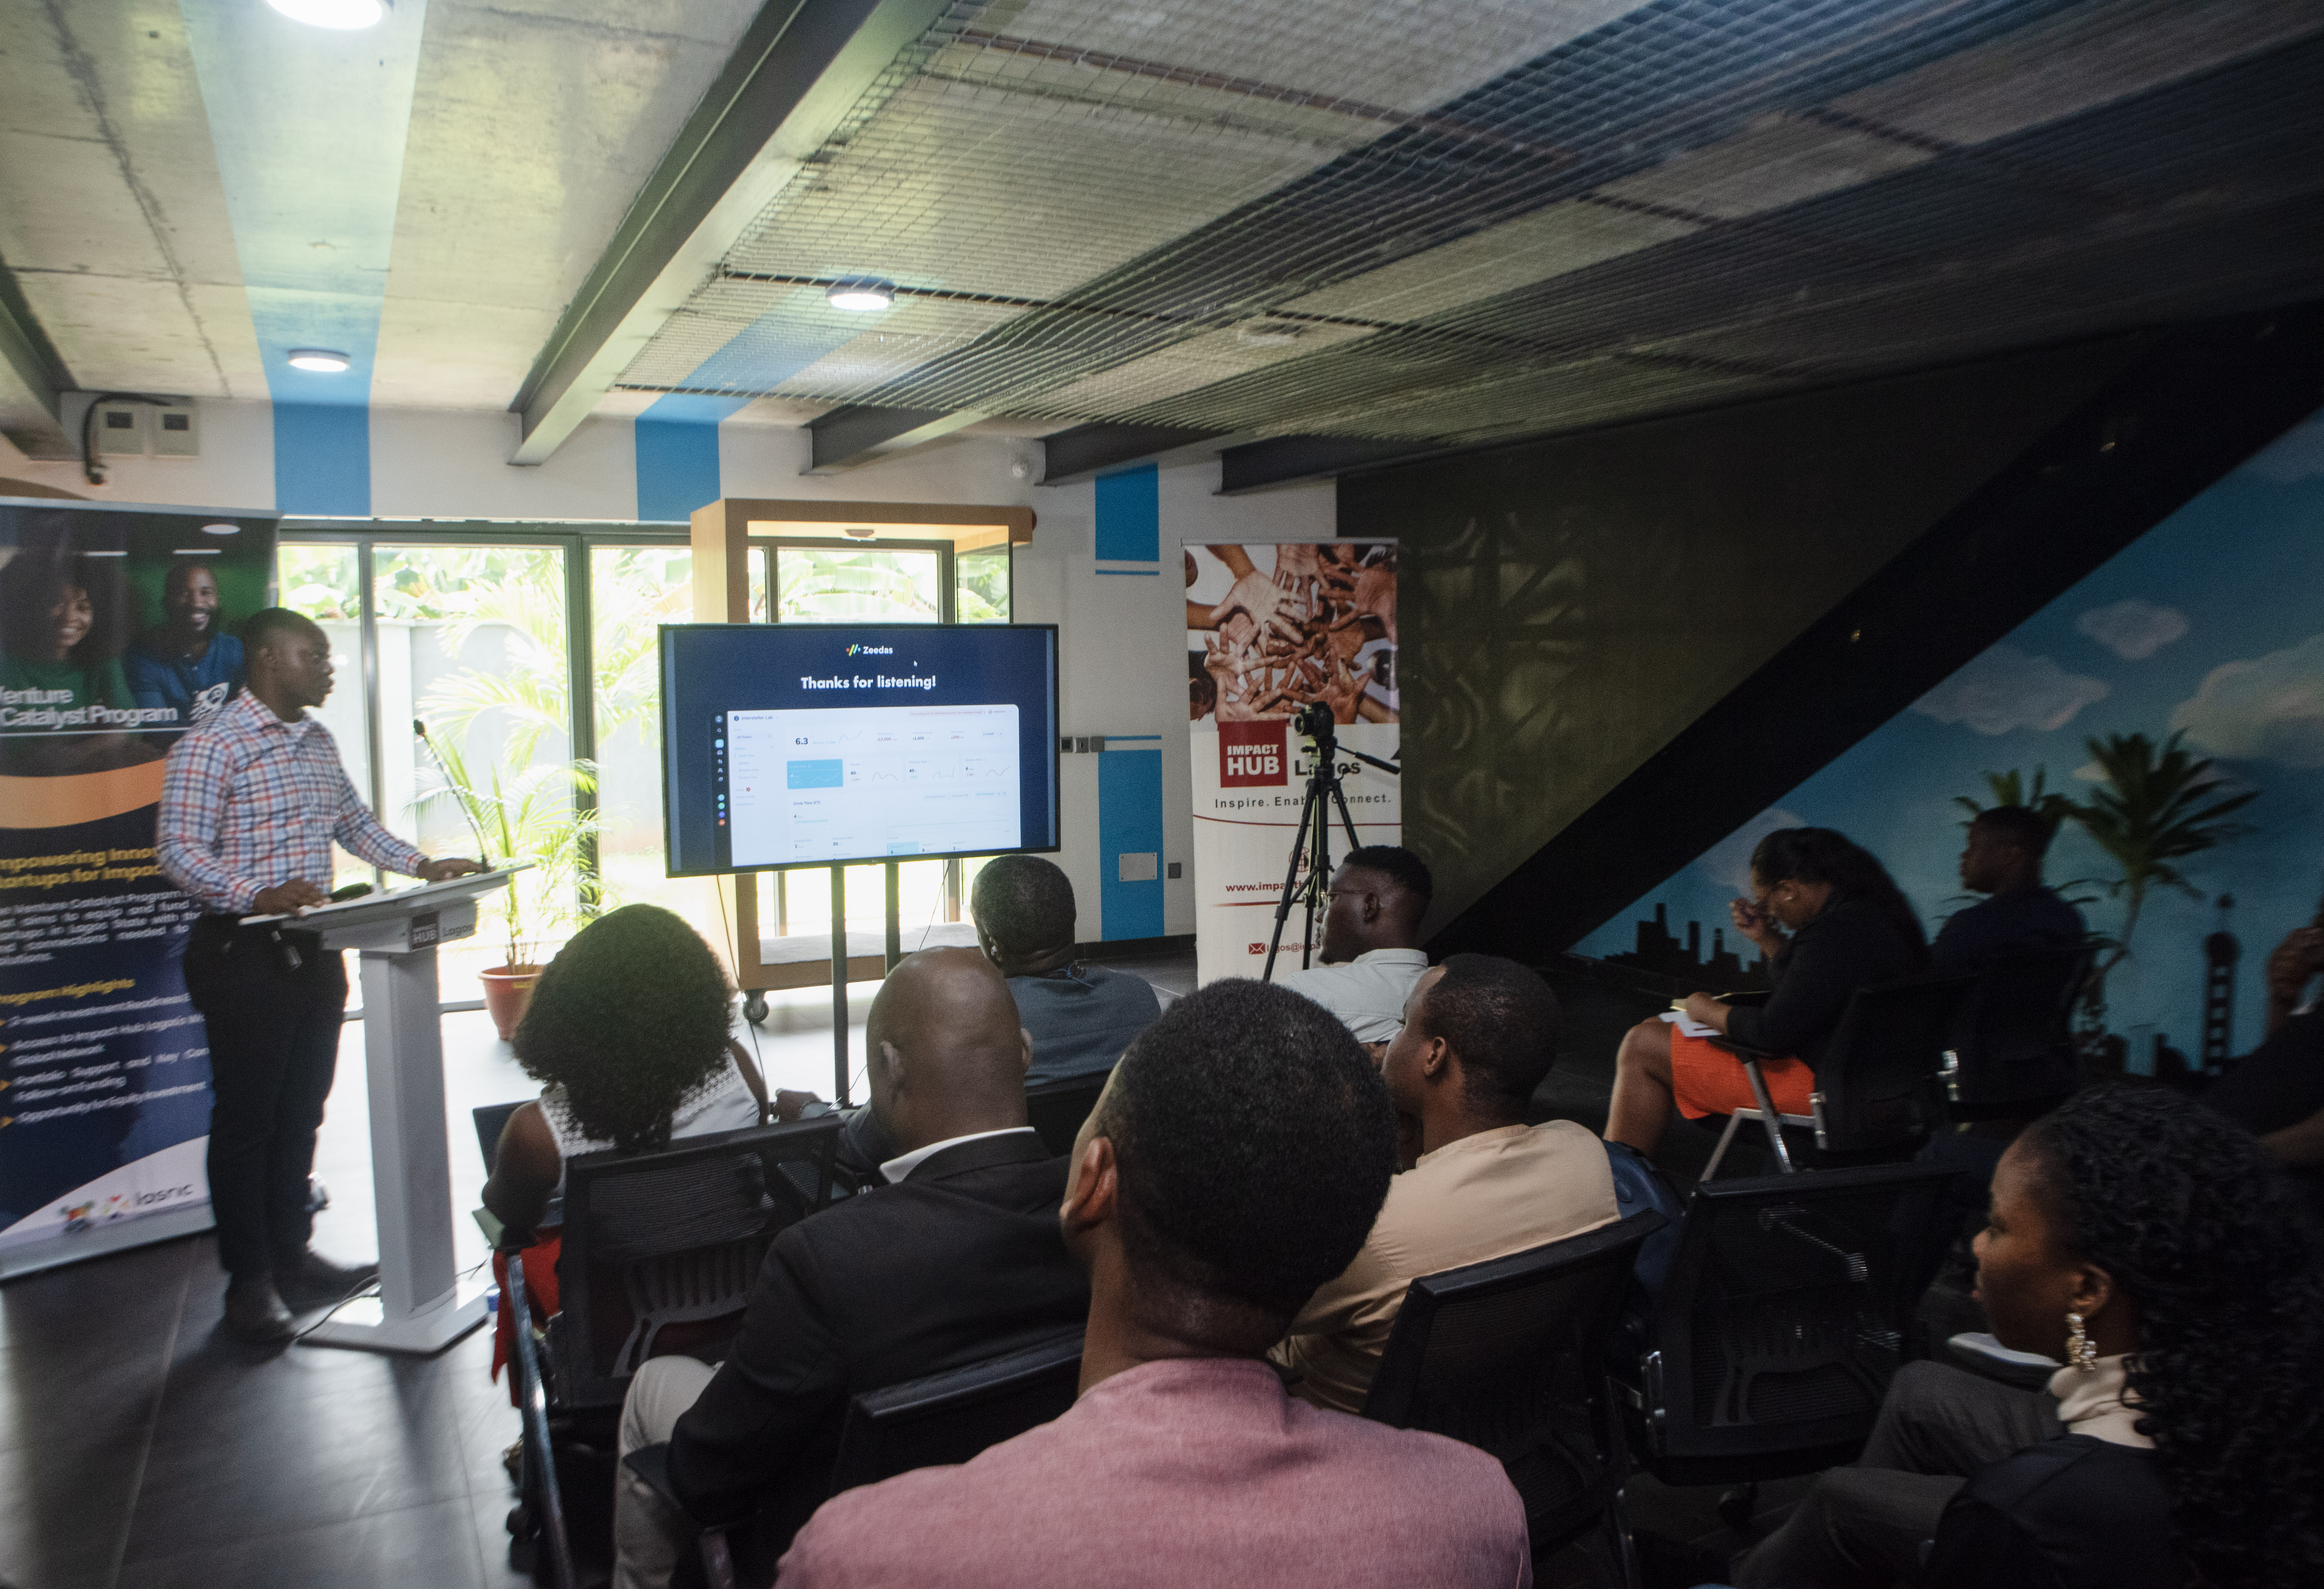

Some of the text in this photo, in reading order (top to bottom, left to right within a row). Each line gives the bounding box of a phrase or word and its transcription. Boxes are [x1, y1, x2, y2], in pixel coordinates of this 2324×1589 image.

[863, 646, 893, 655] Zeedas
[801, 675, 936, 690] Thanks for listening!
[87, 705, 178, 727] Program
[1227, 744, 1279, 755] IMPACT
[1228, 756, 1280, 776] HUB
[1295, 760, 1361, 777] Los
[1215, 798, 1269, 810] Inspire.
[0, 849, 106, 874] mpowering
[0, 874, 70, 890] artups
[71, 867, 101, 883] for
[413, 929, 437, 943] HUB
[442, 924, 474, 937] Lagos
